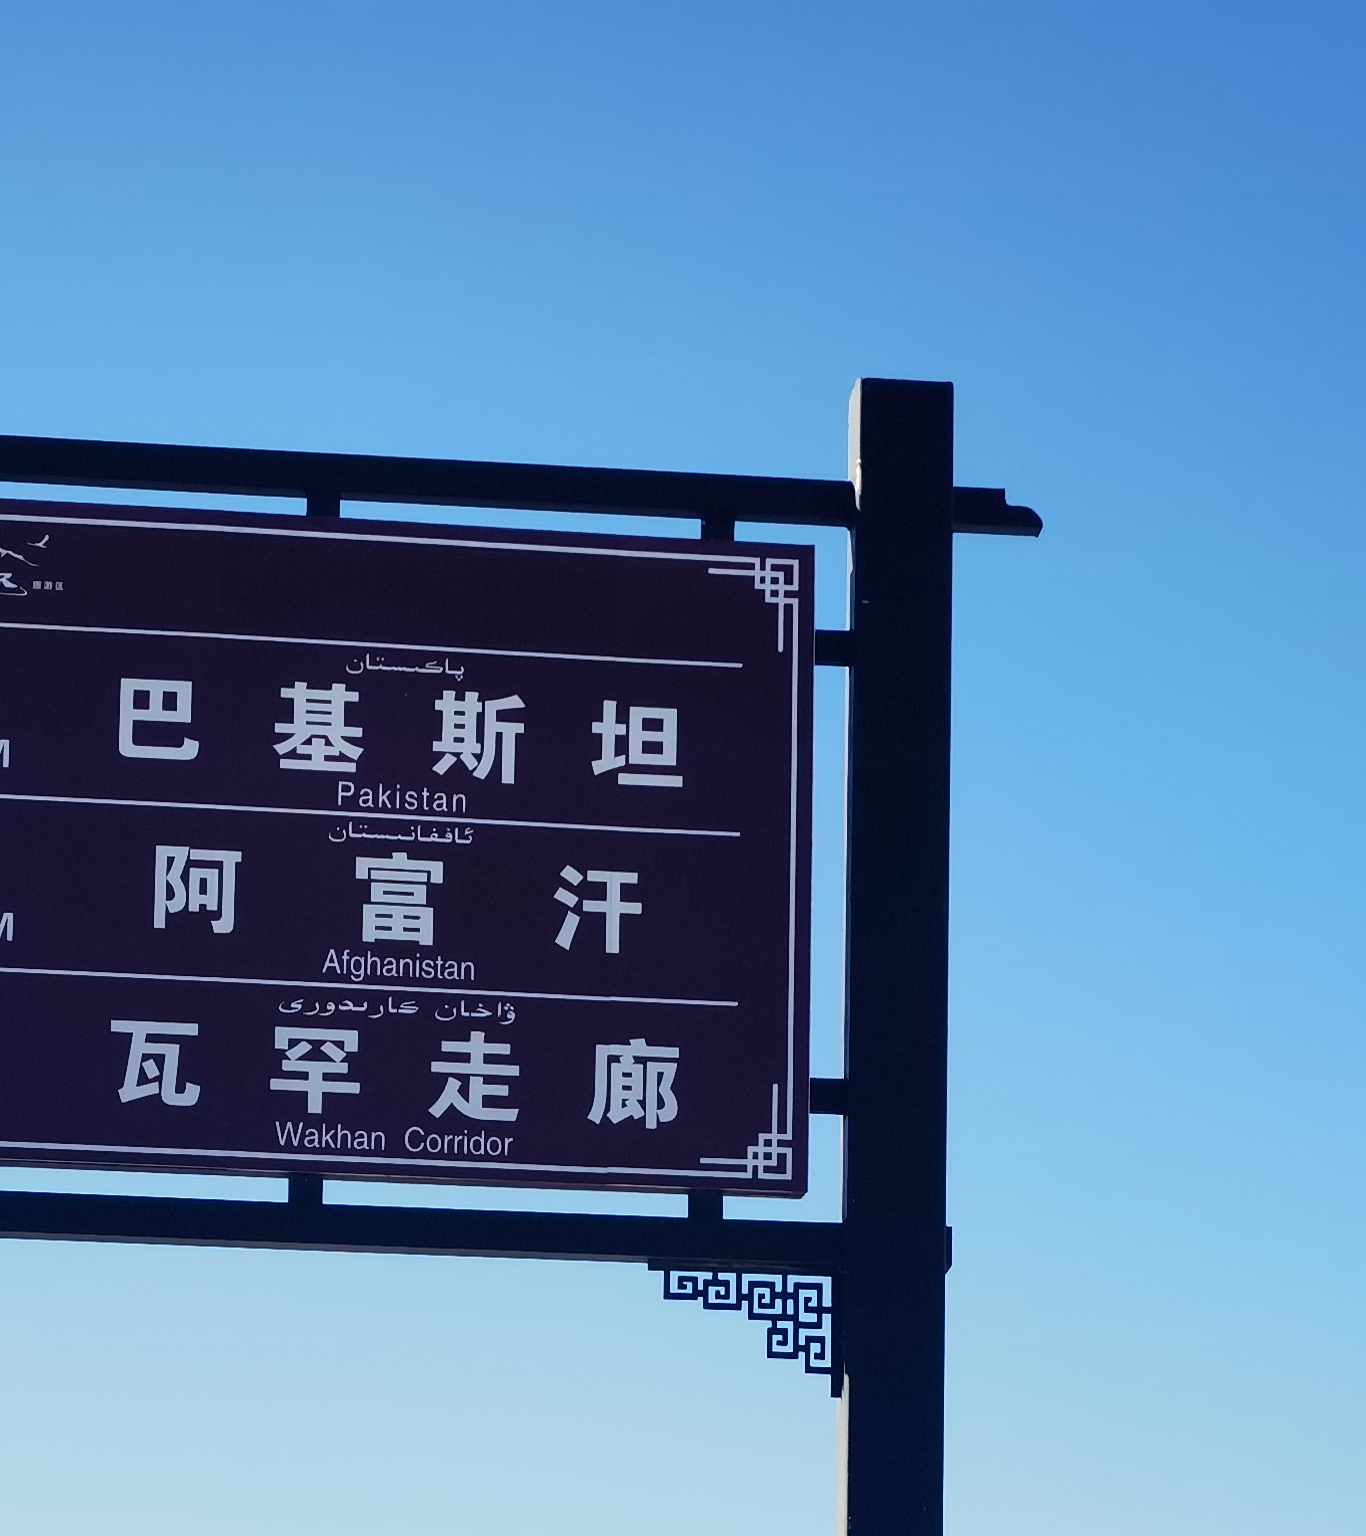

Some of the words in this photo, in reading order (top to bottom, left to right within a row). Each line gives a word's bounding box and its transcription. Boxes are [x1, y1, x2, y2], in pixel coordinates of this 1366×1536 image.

[118, 677, 683, 788] 巴基斯坦
[337, 781, 467, 813] Pakistan
[153, 845, 643, 953] 阿富汗
[322, 949, 475, 982] Afghanistan
[110, 1019, 680, 1129] 瓦罕走廊
[275, 1121, 386, 1151] Wakhan
[404, 1127, 515, 1158] Corridor
